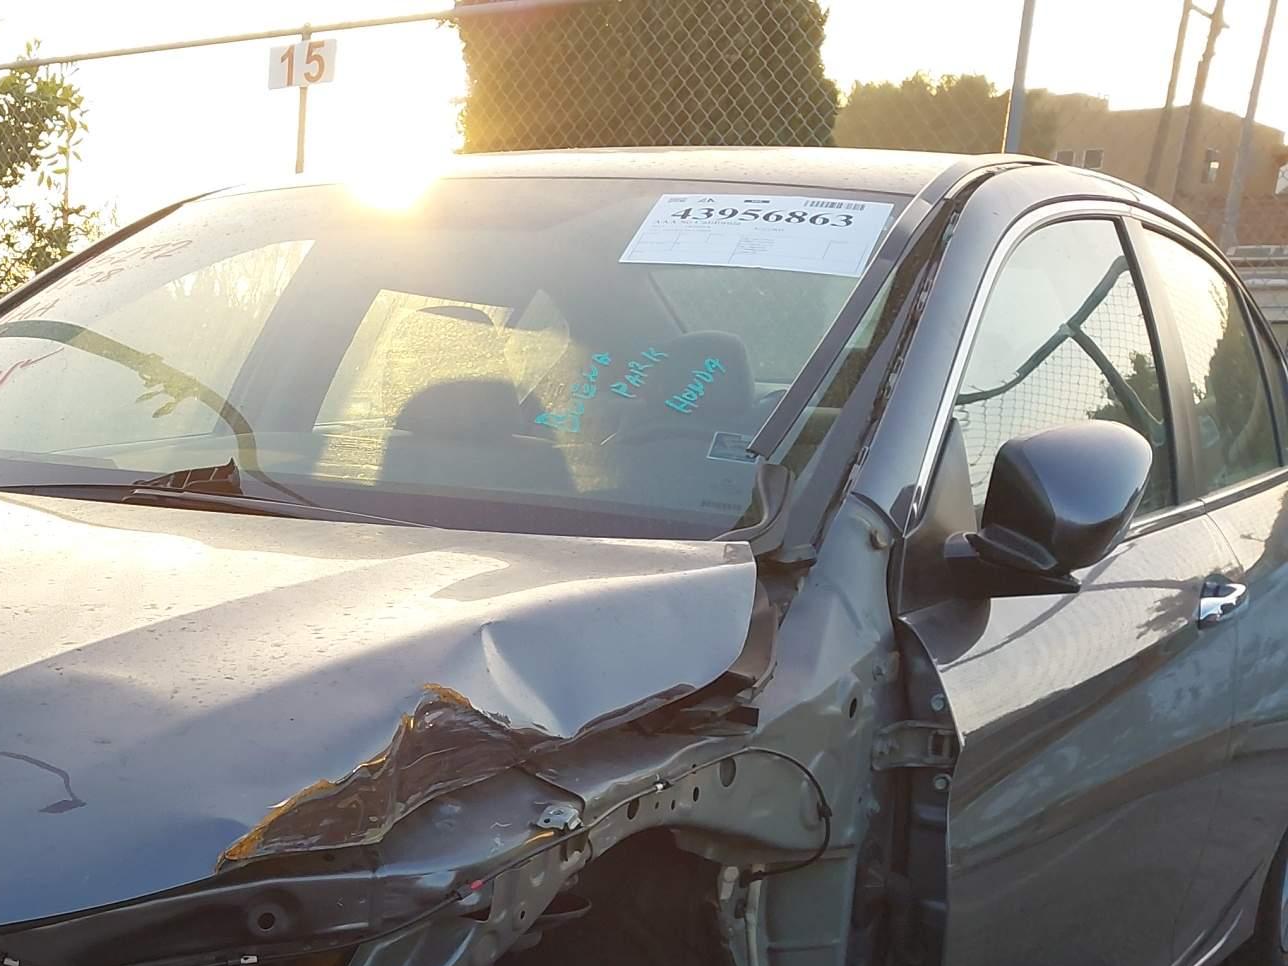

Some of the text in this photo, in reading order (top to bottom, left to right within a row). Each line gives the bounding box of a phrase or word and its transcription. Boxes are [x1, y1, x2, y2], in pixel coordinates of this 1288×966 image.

[280, 40, 325, 87] 15
[671, 206, 854, 228] 43956863
[608, 346, 669, 399] PARK
